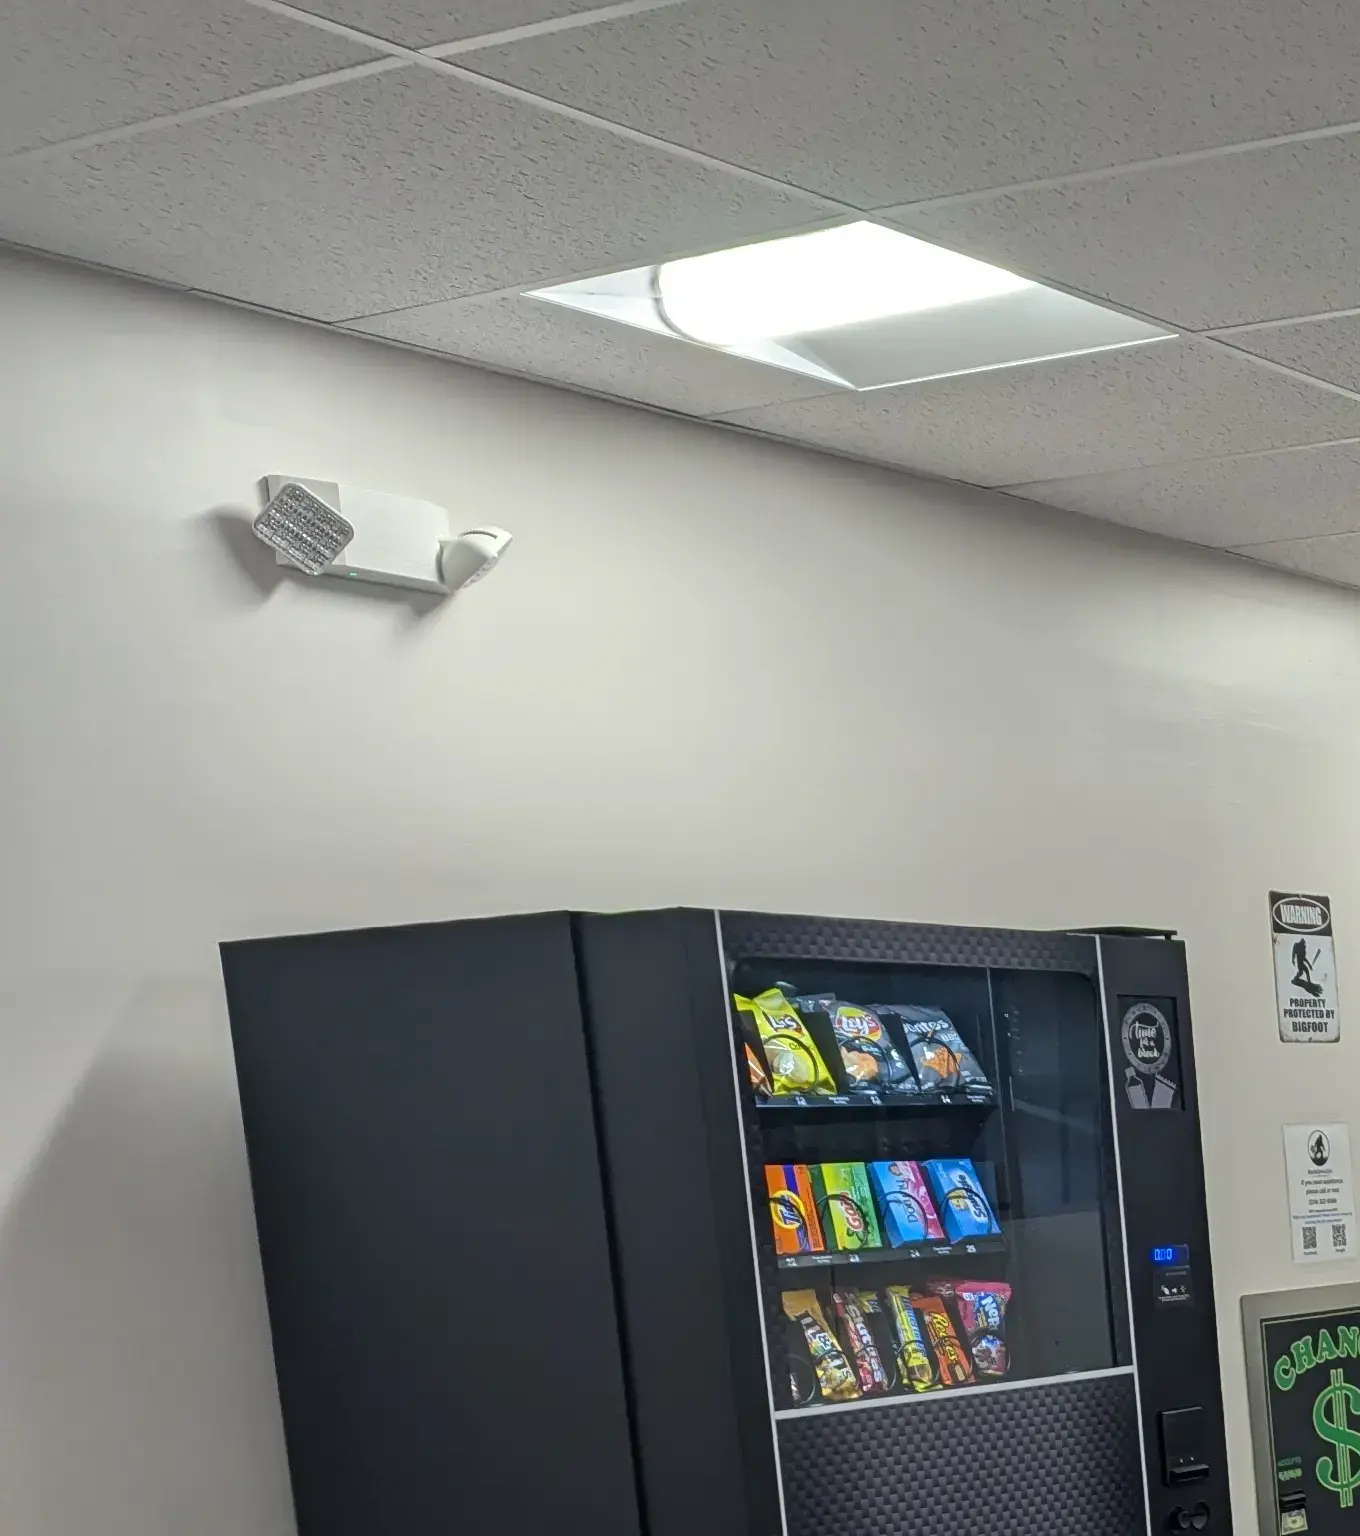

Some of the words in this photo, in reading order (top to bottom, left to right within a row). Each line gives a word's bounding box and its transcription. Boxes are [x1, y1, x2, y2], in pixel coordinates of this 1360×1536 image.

[1280, 904, 1322, 925] WARNING
[1289, 998, 1326, 1009] PROPERTY
[1283, 1008, 1325, 1019] PROTECTED
[1326, 1009, 1335, 1019] BY
[842, 1015, 876, 1036] Lay's
[1292, 1021, 1329, 1033] BIGFOOT
